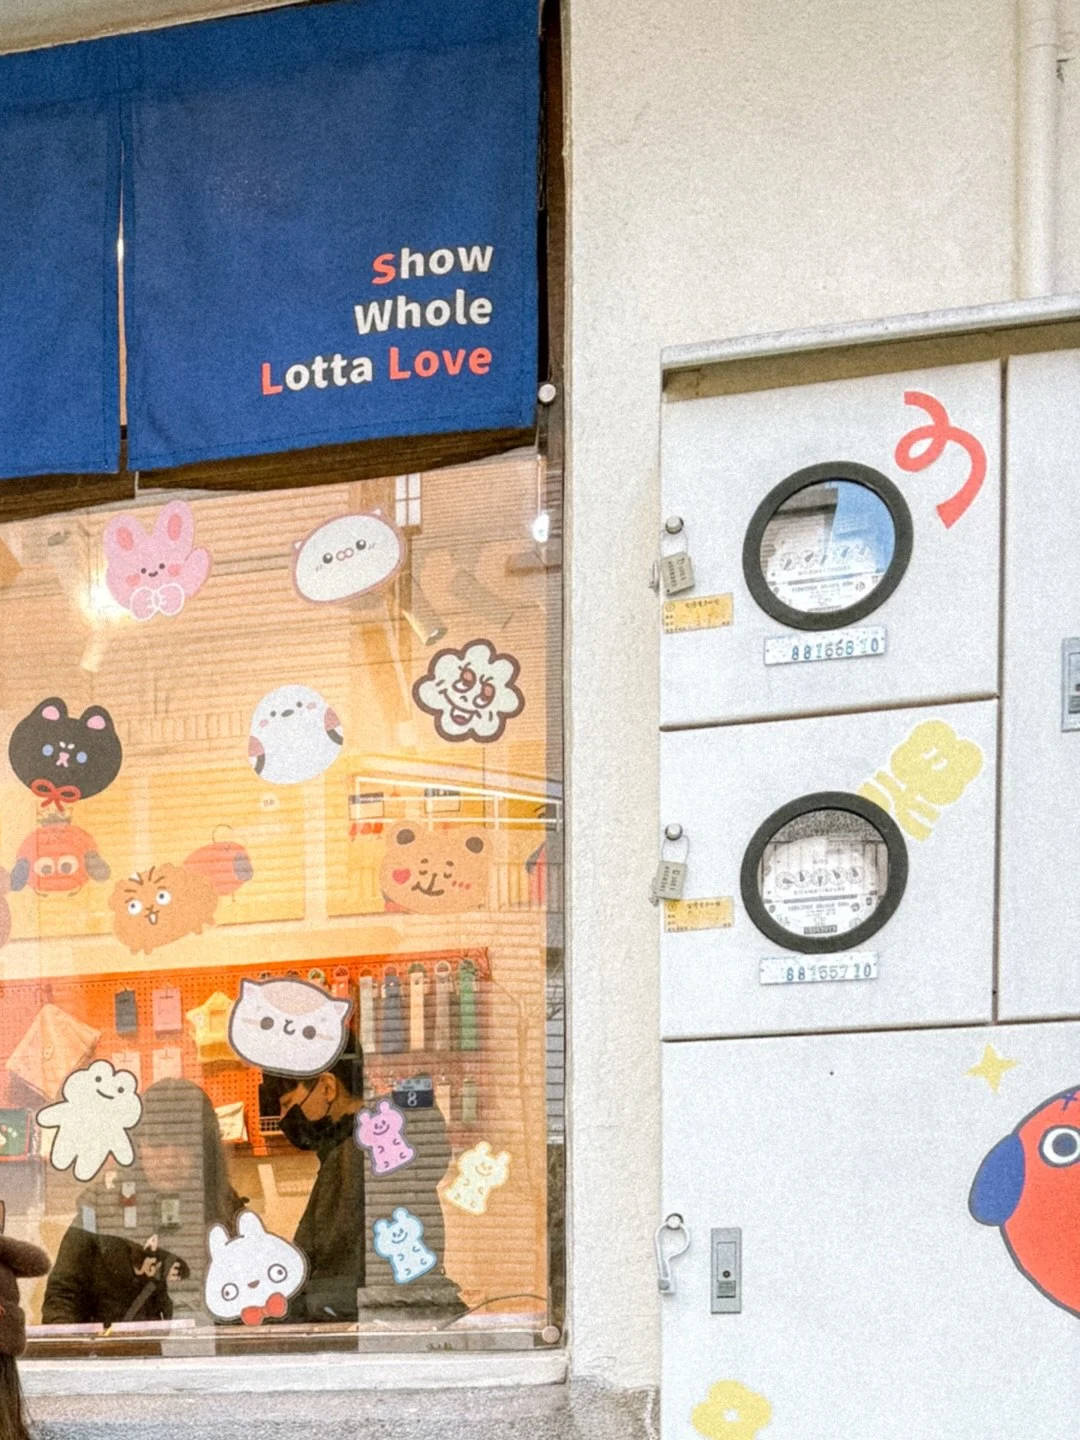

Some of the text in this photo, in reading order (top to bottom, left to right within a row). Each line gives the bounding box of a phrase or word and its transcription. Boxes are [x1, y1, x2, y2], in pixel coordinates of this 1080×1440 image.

[354, 289, 493, 335] Whole
[261, 346, 493, 395] Lotta Love
